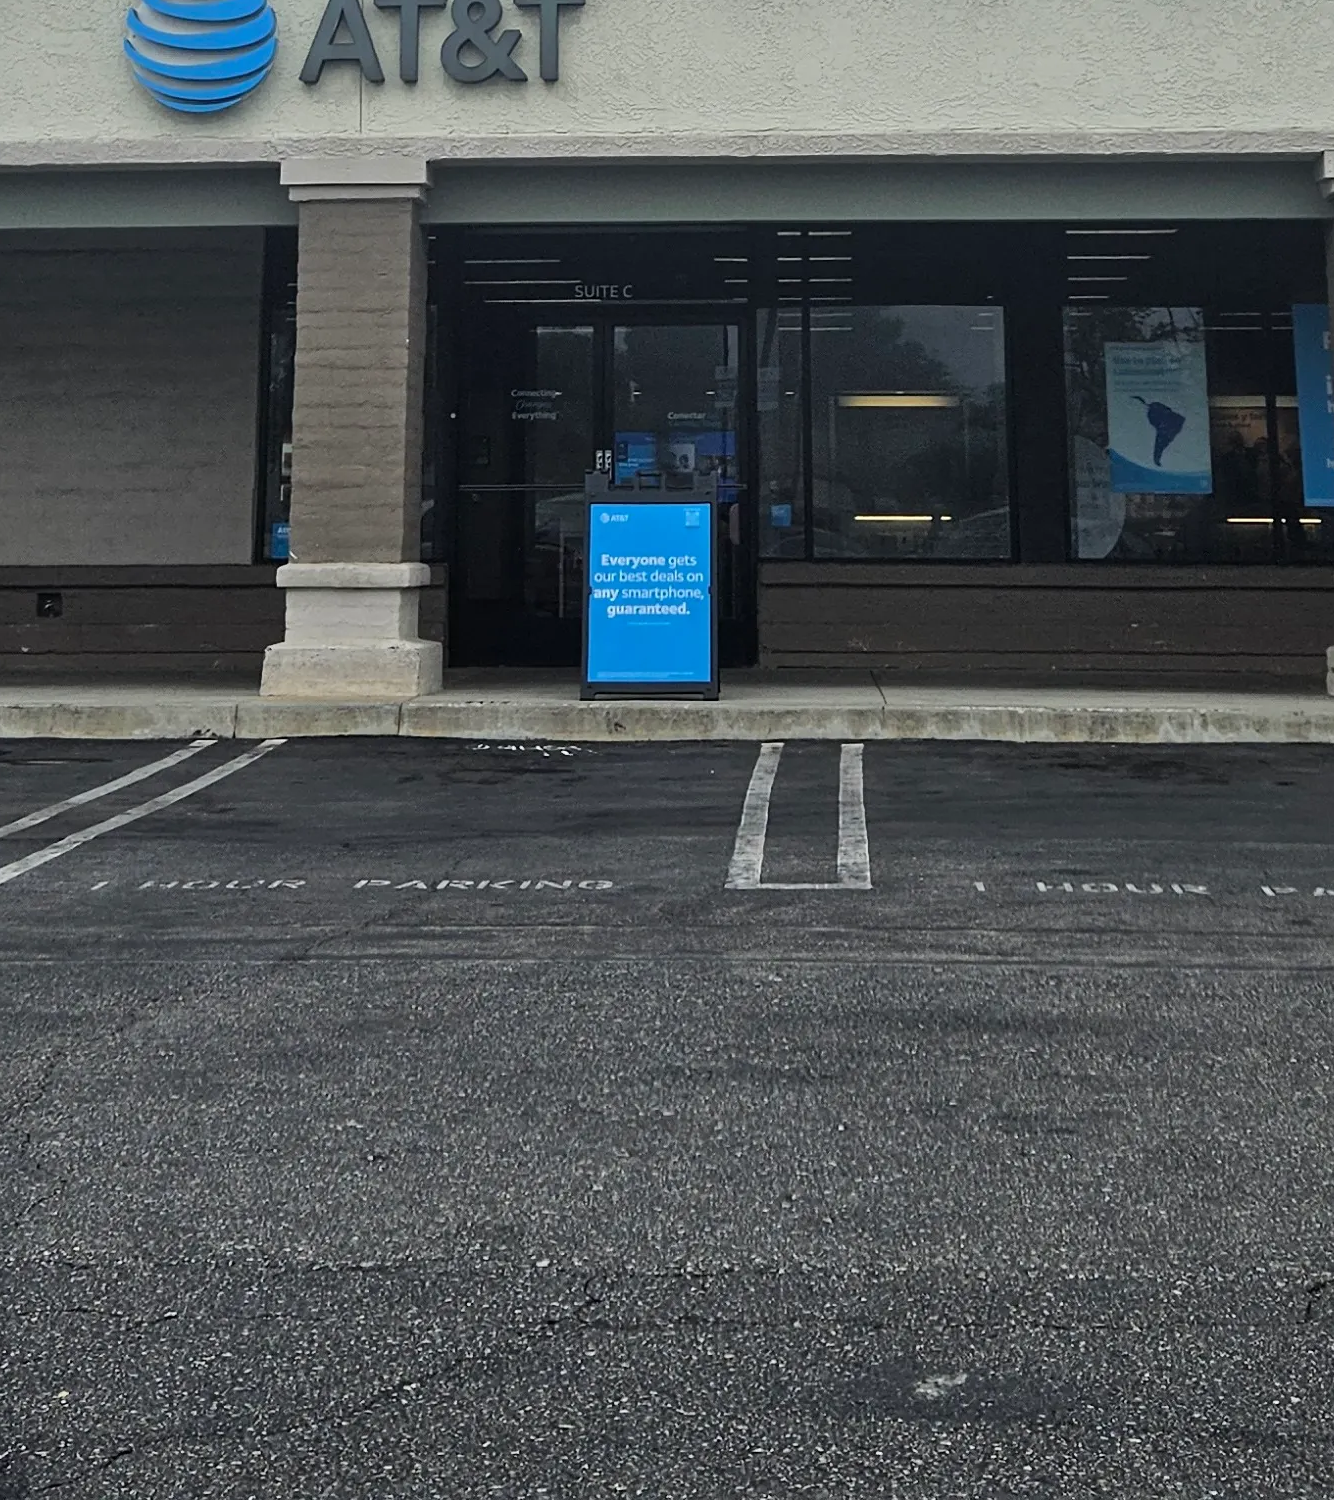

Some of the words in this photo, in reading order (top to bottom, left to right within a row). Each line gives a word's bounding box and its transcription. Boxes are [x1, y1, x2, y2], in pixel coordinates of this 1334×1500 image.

[574, 285, 618, 298] SUITE
[622, 285, 633, 298] C
[601, 554, 666, 569] Everyone
[669, 555, 697, 568] gets
[594, 572, 616, 582] our
[619, 570, 648, 582] best
[650, 570, 684, 582] deals
[686, 572, 704, 582] on
[593, 588, 619, 602] any
[621, 586, 705, 601] smartphone,
[607, 602, 691, 618] guaranteed.
[137, 879, 307, 890] HOUR
[352, 879, 614, 890] PARKING
[1036, 881, 1211, 895] HOUR
